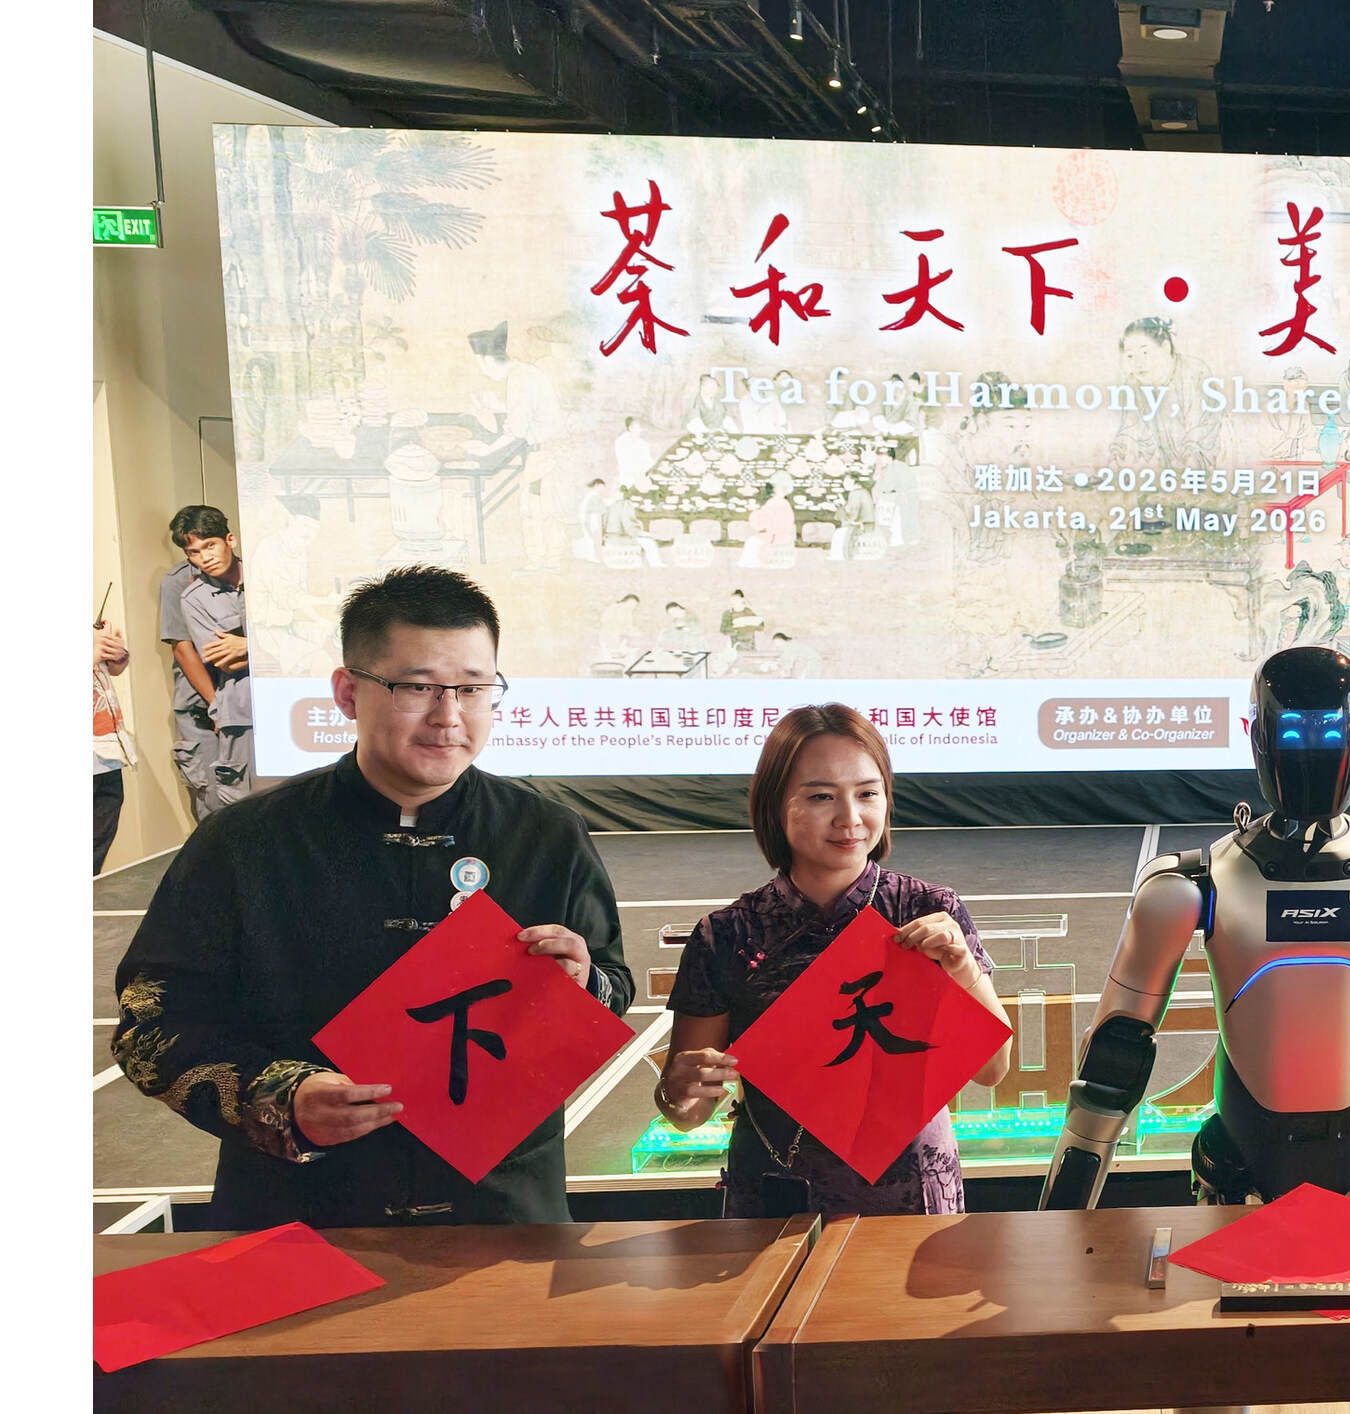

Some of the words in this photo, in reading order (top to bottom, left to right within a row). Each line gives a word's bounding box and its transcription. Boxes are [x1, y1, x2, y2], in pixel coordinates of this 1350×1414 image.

[123, 218, 150, 235] EXIT
[710, 367, 806, 406] Tea
[826, 367, 906, 408] for
[926, 370, 1179, 418] Harmony,
[969, 504, 1097, 534] Jakarta,
[1108, 501, 1165, 531] 21st
[1175, 507, 1239, 537] May
[1249, 508, 1326, 533] 2026
[306, 706, 357, 727] 主办
[1055, 705, 1213, 726] 承办&协办单位
[313, 730, 358, 744] Hoste
[487, 734, 548, 749] mbassy
[552, 734, 567, 746] of
[571, 734, 595, 746] the
[600, 734, 662, 749] People's
[666, 734, 731, 749] Republic
[735, 734, 748, 746] of
[911, 733, 924, 746] of
[928, 733, 997, 746] Indonesia
[1053, 728, 1116, 744] Organizer
[1118, 728, 1128, 741] &
[1131, 727, 1216, 743] Co-Organizer
[822, 970, 940, 1068] 天
[405, 978, 514, 1106] 下
